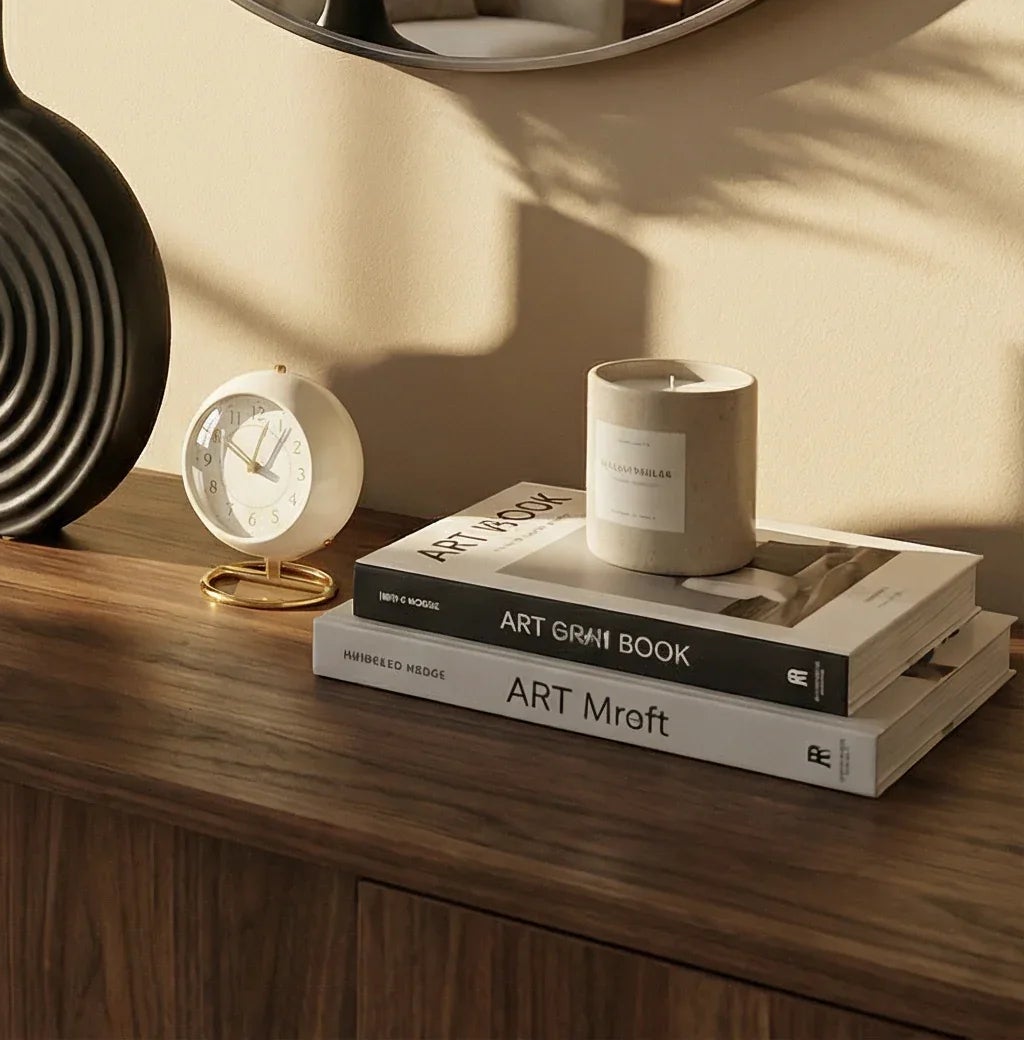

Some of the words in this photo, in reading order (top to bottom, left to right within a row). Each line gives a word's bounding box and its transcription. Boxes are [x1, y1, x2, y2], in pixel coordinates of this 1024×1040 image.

[292, 440, 302, 455] 2
[203, 453, 213, 468] 9
[296, 467, 306, 482] 3
[209, 479, 218, 495] 8
[288, 492, 298, 507] 4
[247, 512, 257, 527] 6
[270, 509, 280, 525] 5
[417, 531, 488, 564] ART
[500, 610, 546, 638] ART
[619, 632, 690, 667] BOOK
[506, 676, 573, 715] ART
